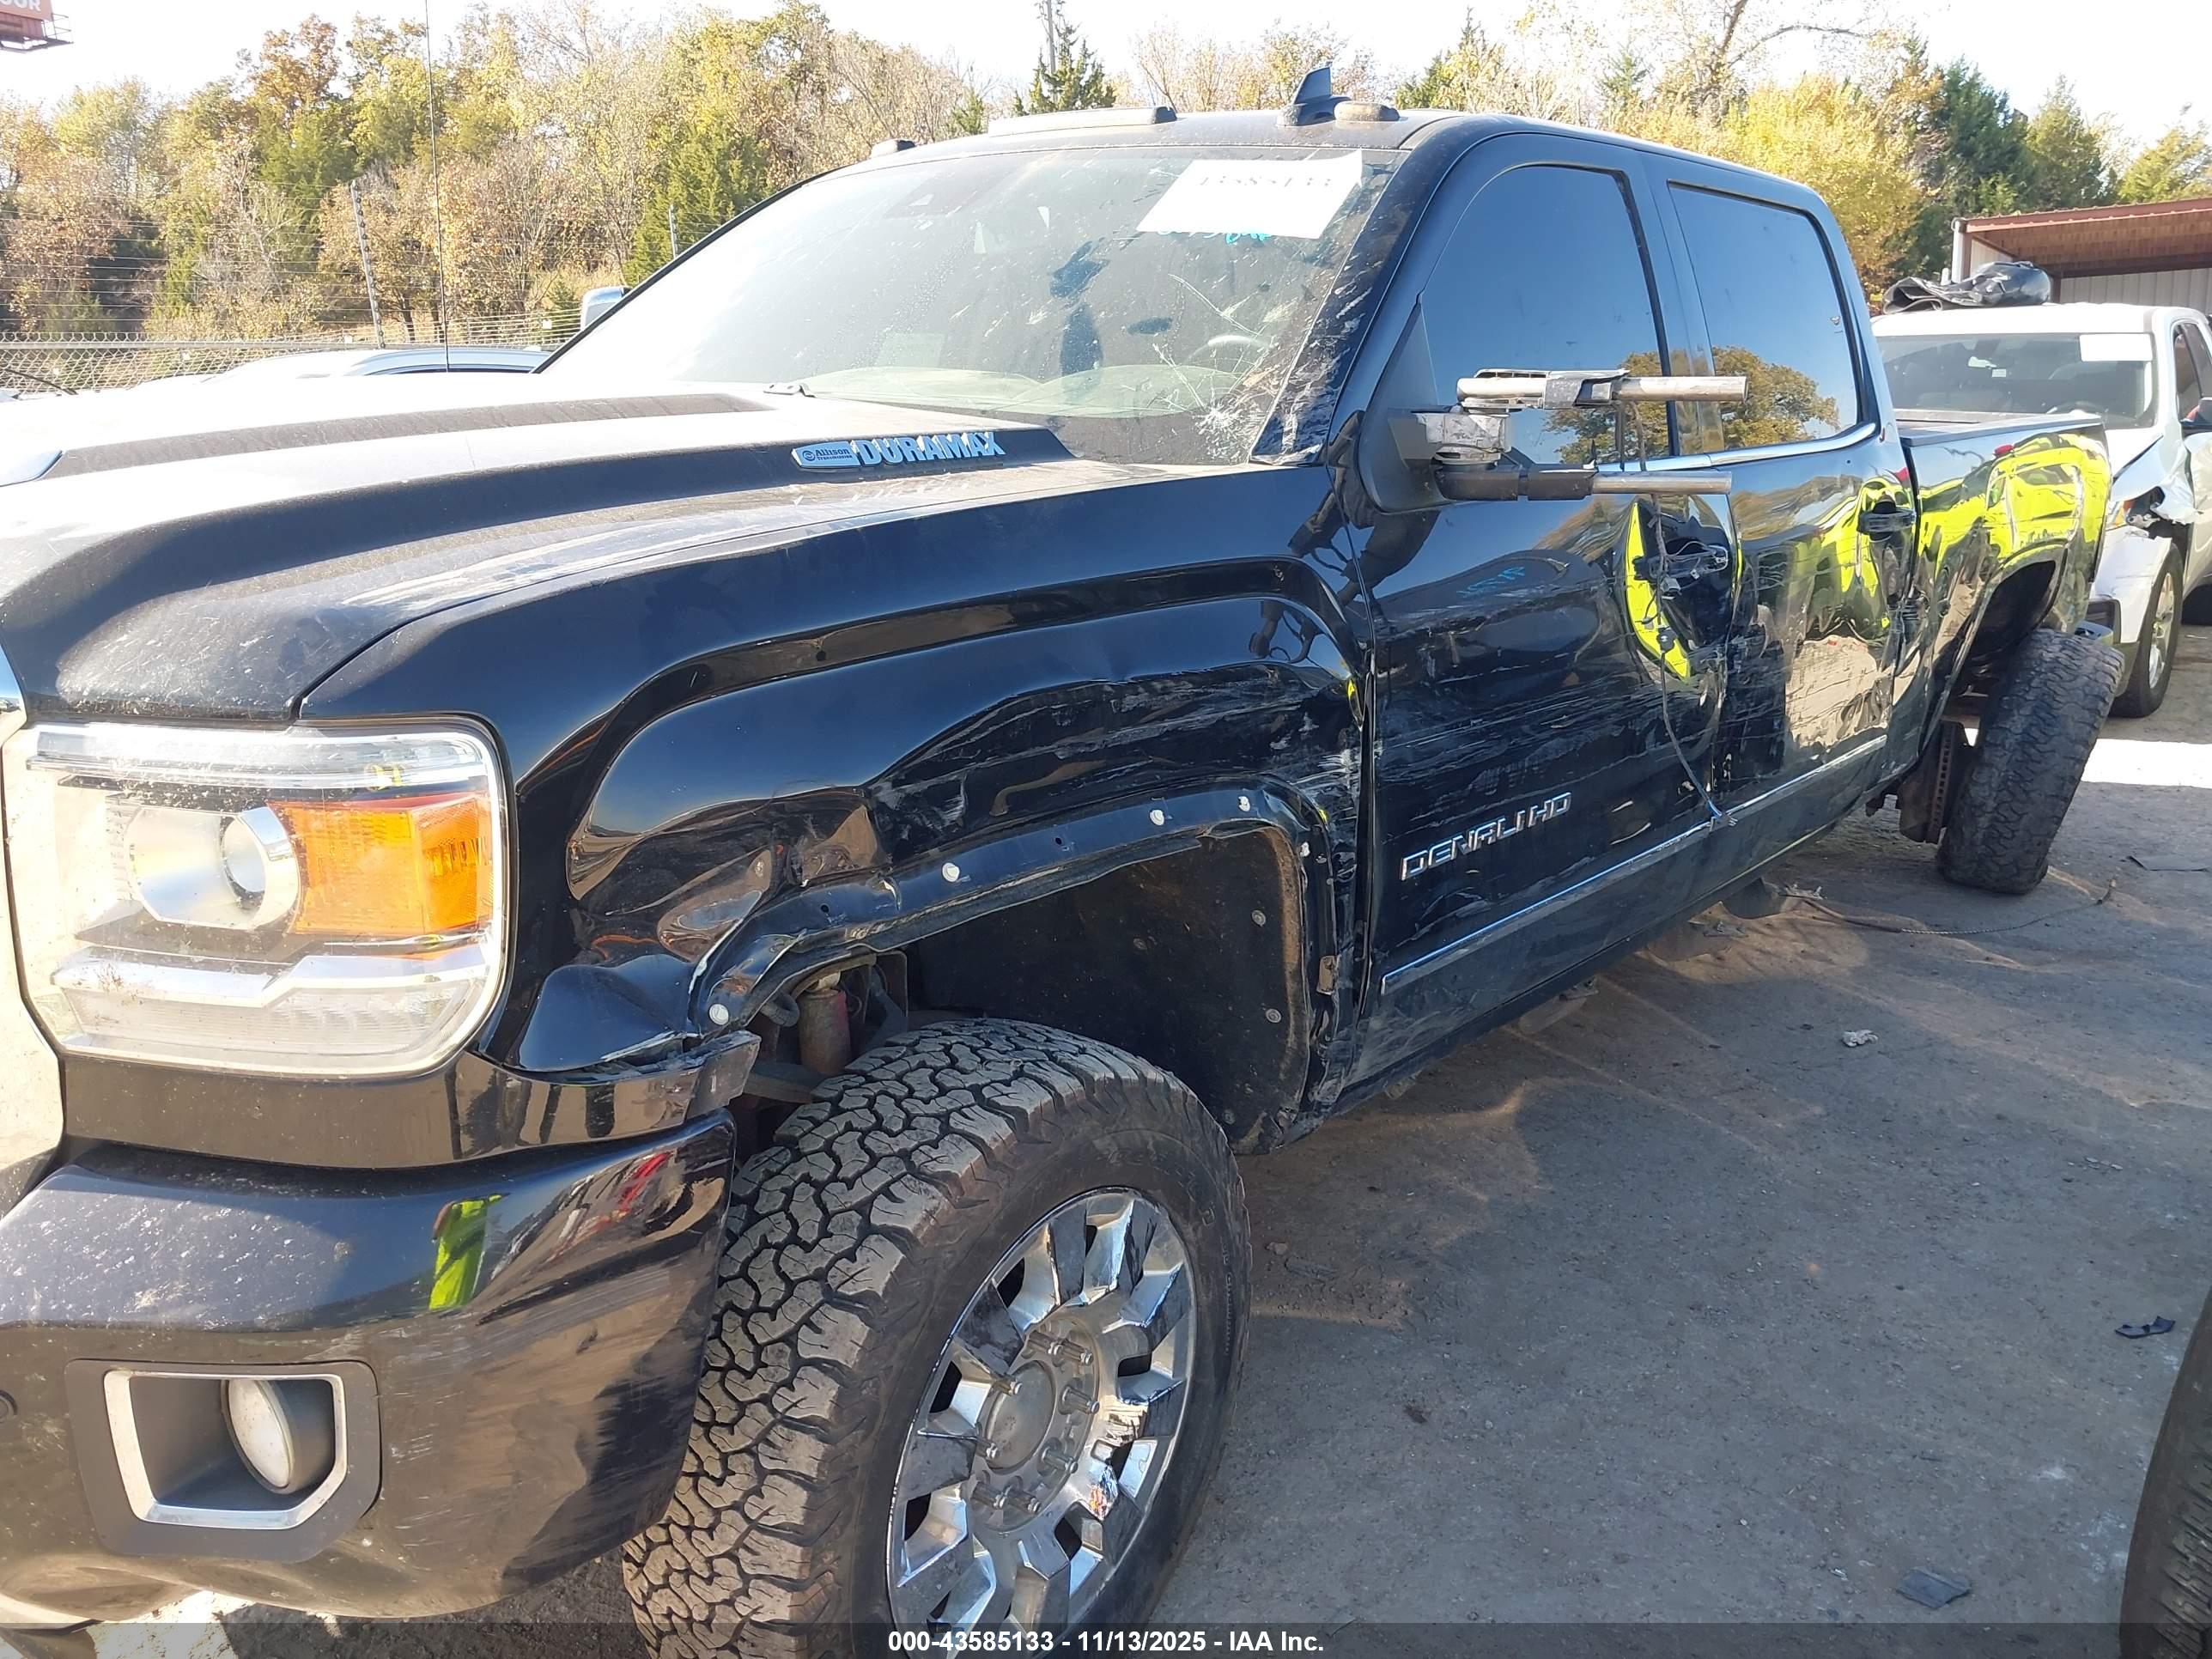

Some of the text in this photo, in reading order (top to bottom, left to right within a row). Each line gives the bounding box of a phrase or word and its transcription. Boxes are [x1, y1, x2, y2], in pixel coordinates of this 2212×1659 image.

[815, 448, 850, 458] Allison
[851, 431, 1006, 465] DURAMAX
[1400, 791, 1572, 881] DENALI HD
